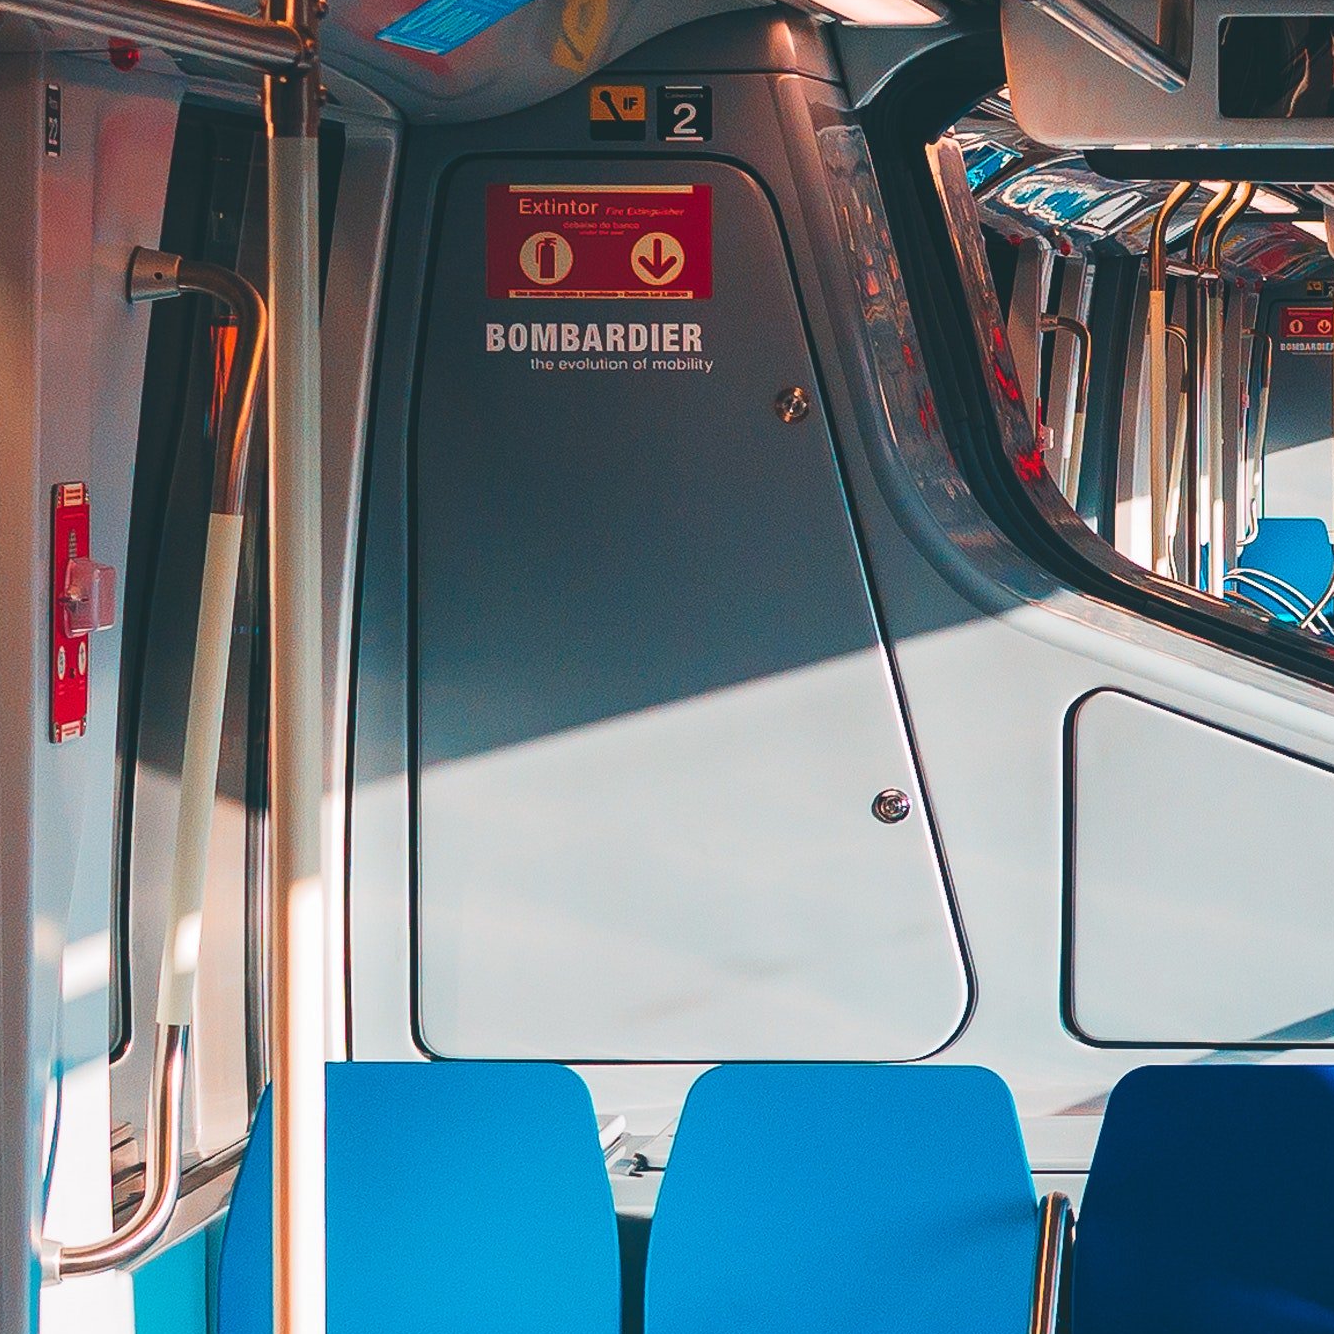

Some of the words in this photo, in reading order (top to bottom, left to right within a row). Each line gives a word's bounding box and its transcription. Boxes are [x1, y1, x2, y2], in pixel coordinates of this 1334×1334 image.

[673, 102, 697, 134] 2
[519, 198, 599, 215] Extintor
[605, 207, 623, 216] Fire
[486, 323, 703, 352] BOMBARDIER
[530, 358, 554, 370] the
[558, 358, 628, 370] evolution
[632, 358, 647, 370] of
[652, 358, 713, 374] mobility
